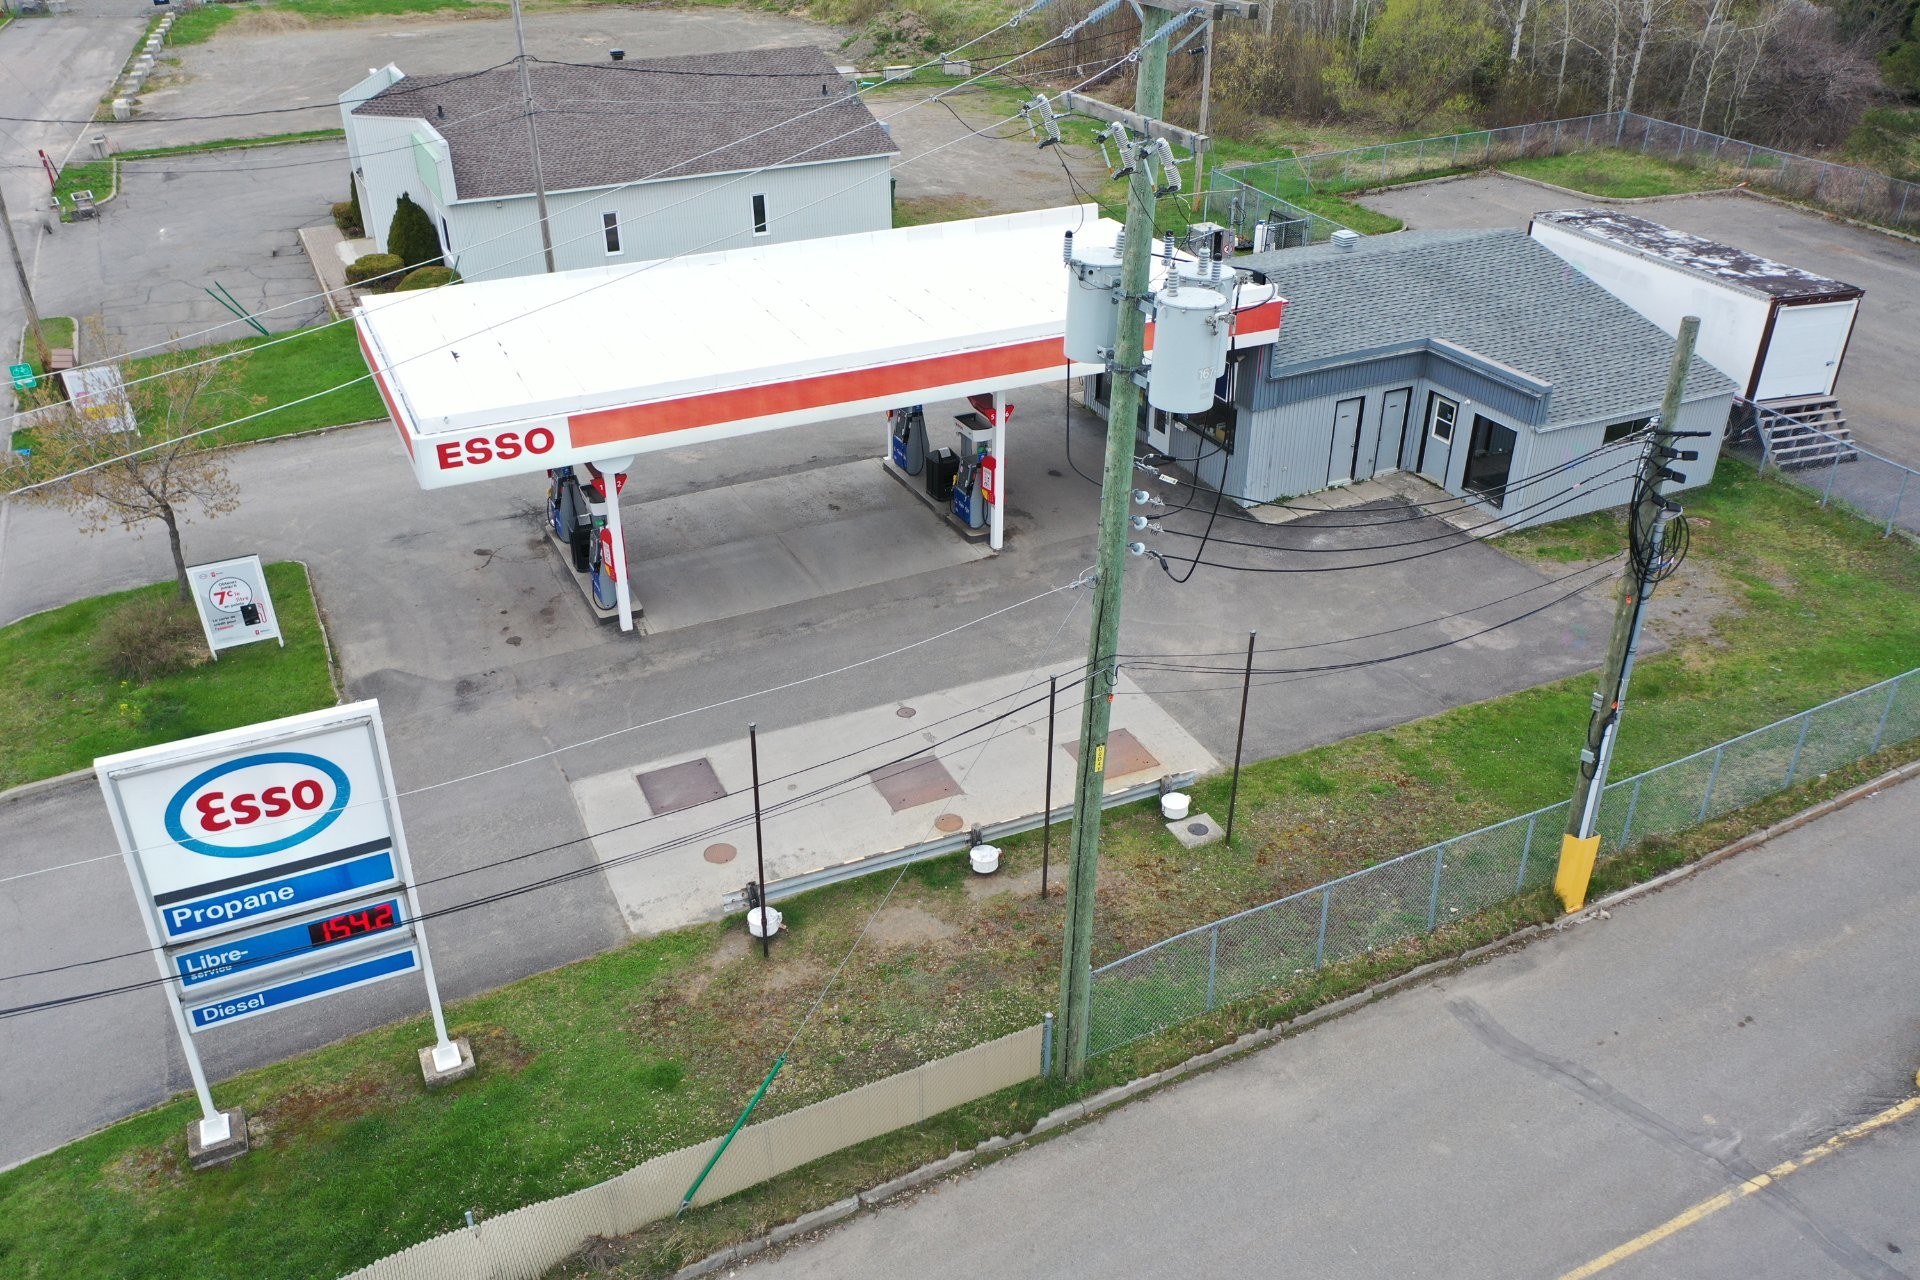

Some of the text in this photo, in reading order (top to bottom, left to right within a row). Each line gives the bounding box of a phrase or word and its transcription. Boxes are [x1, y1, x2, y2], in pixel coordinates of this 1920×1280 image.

[436, 427, 555, 470] ESSO
[171, 886, 295, 928] Propane
[322, 903, 393, 942] 154.2
[185, 949, 249, 973] Libre-
[202, 994, 265, 1022] Diesel
